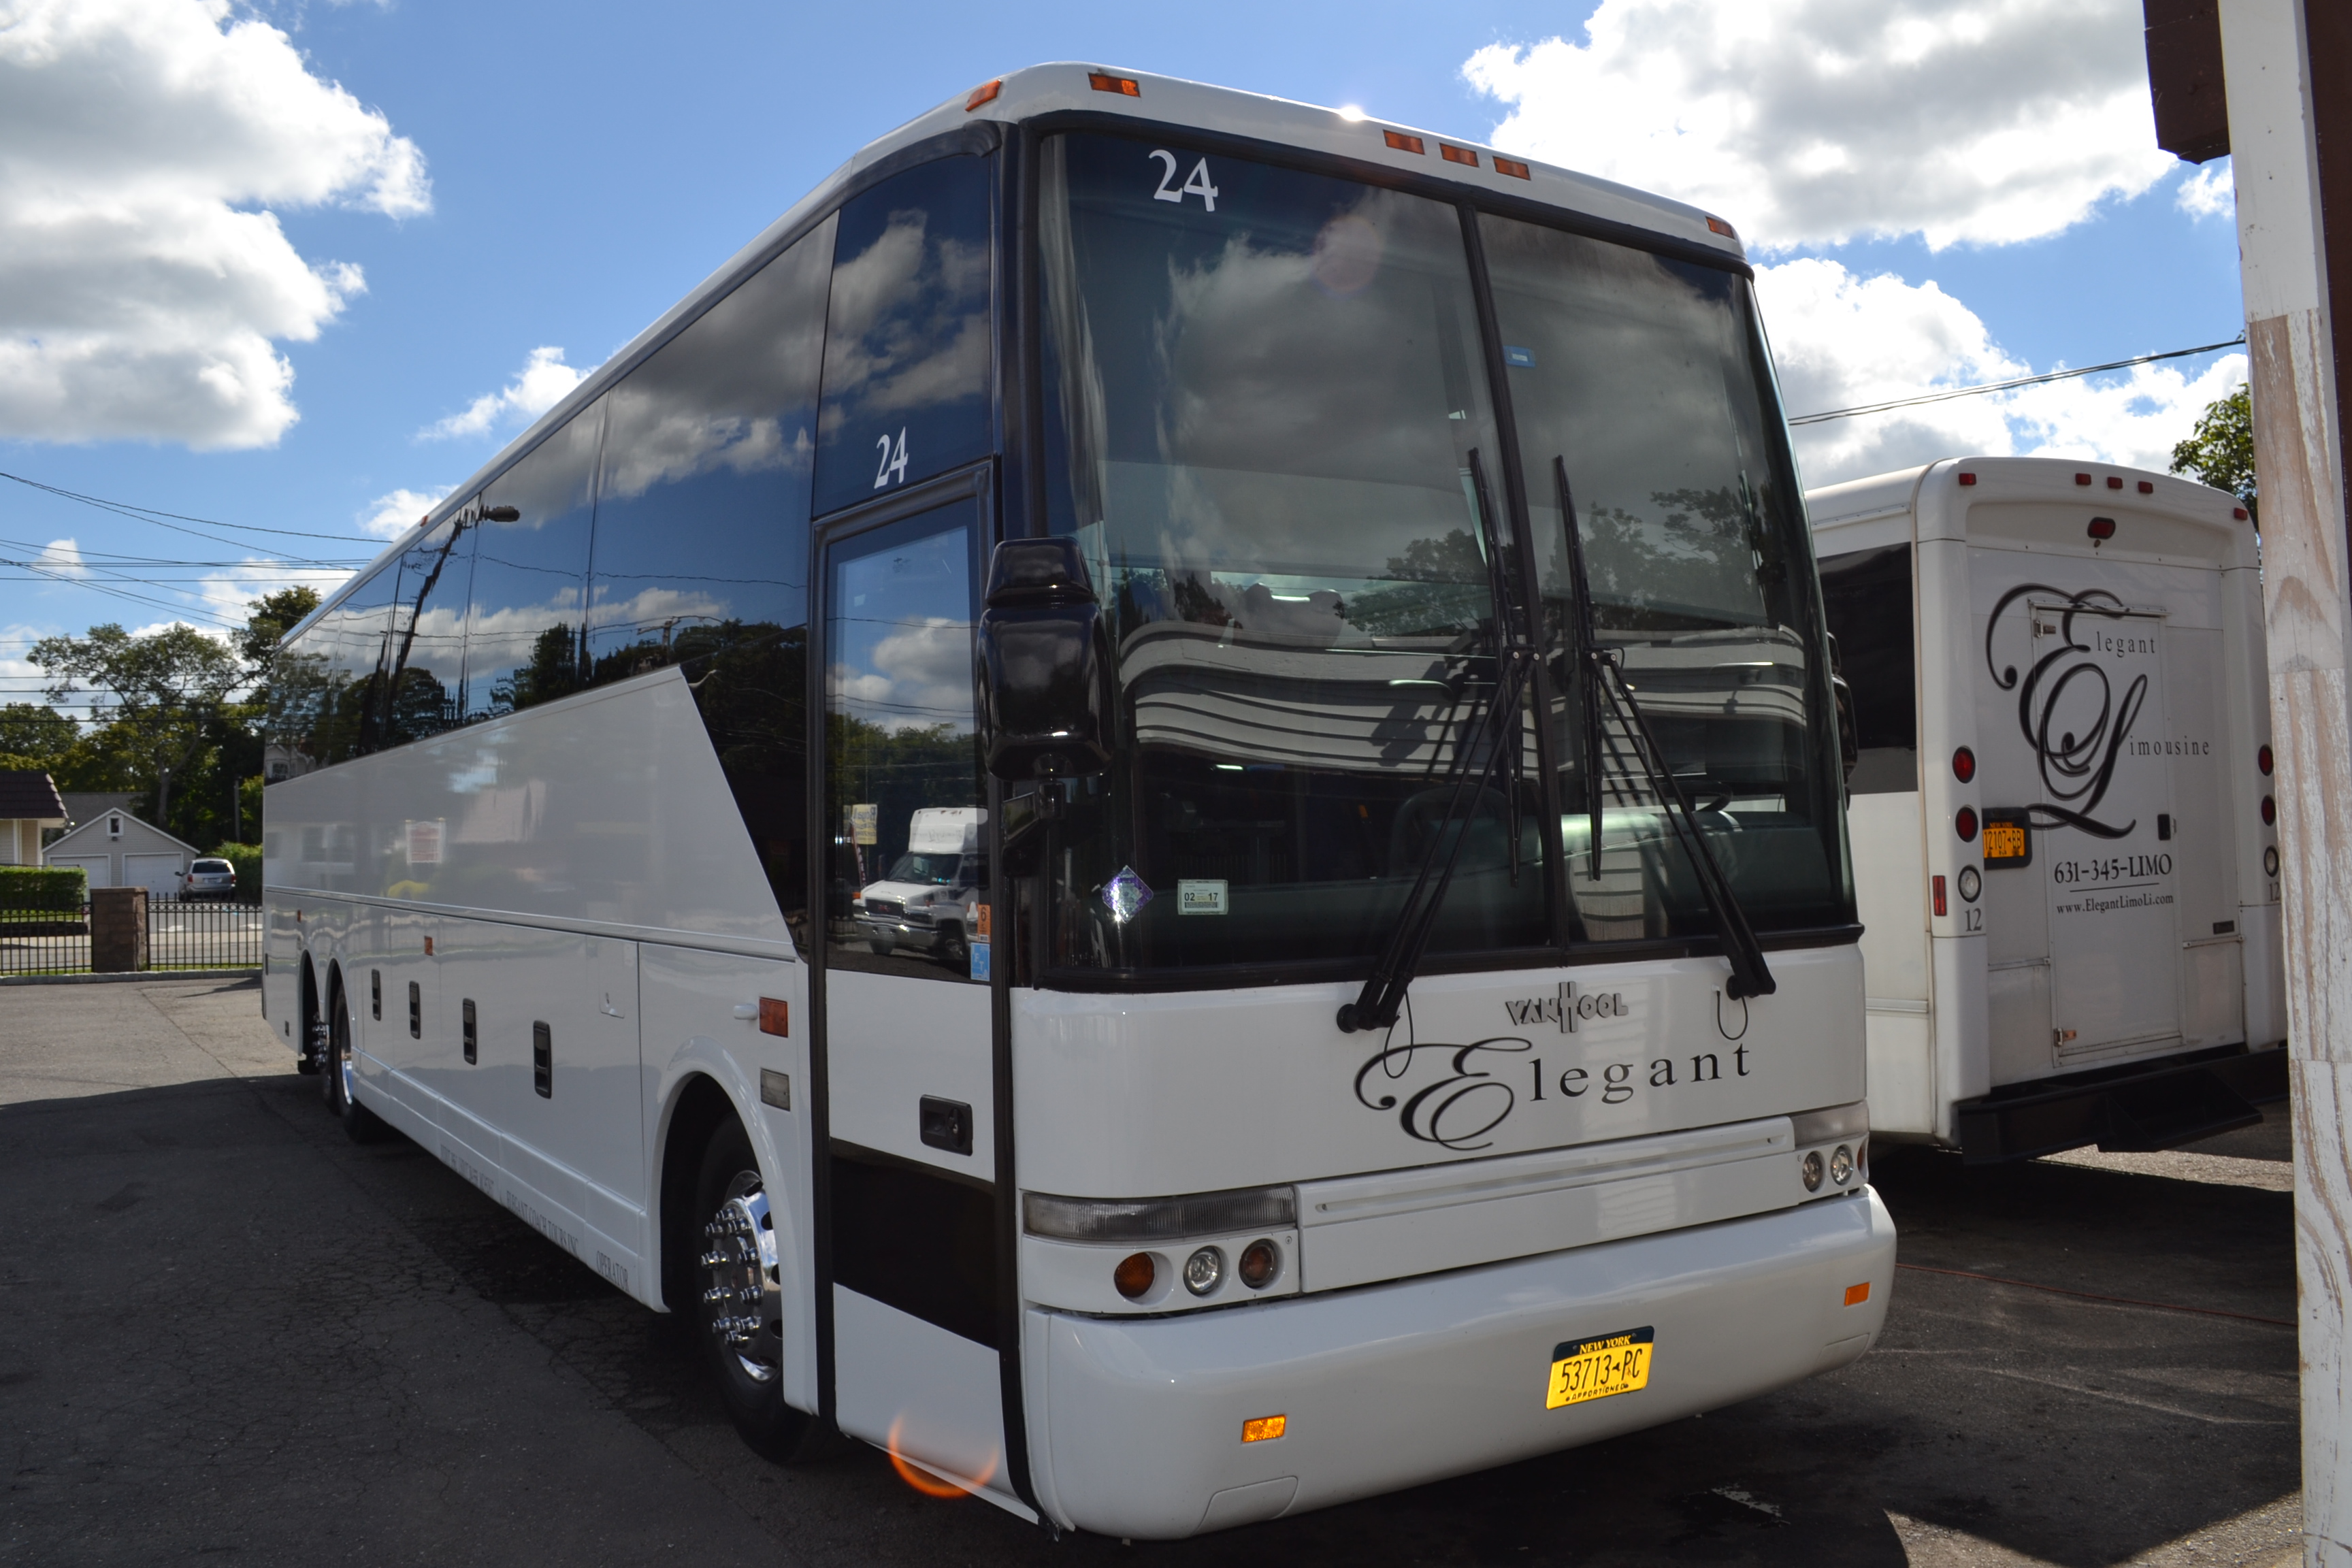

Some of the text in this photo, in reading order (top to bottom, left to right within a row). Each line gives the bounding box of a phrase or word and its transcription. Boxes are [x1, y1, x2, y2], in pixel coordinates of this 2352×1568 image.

[1148, 149, 1219, 212] 24
[874, 426, 909, 489] 24
[2054, 853, 2172, 884] 631-345-LIMO
[1184, 892, 1218, 902] 02 17
[2056, 893, 2174, 915] www.ElegantLimoLi.com
[1965, 907, 1982, 932] 12
[1353, 1036, 1751, 1151] Elegant
[596, 1250, 630, 1293] OPERATOR
[1580, 1335, 1631, 1355] NEW YORK
[1559, 1348, 1643, 1394] 53713-PC
